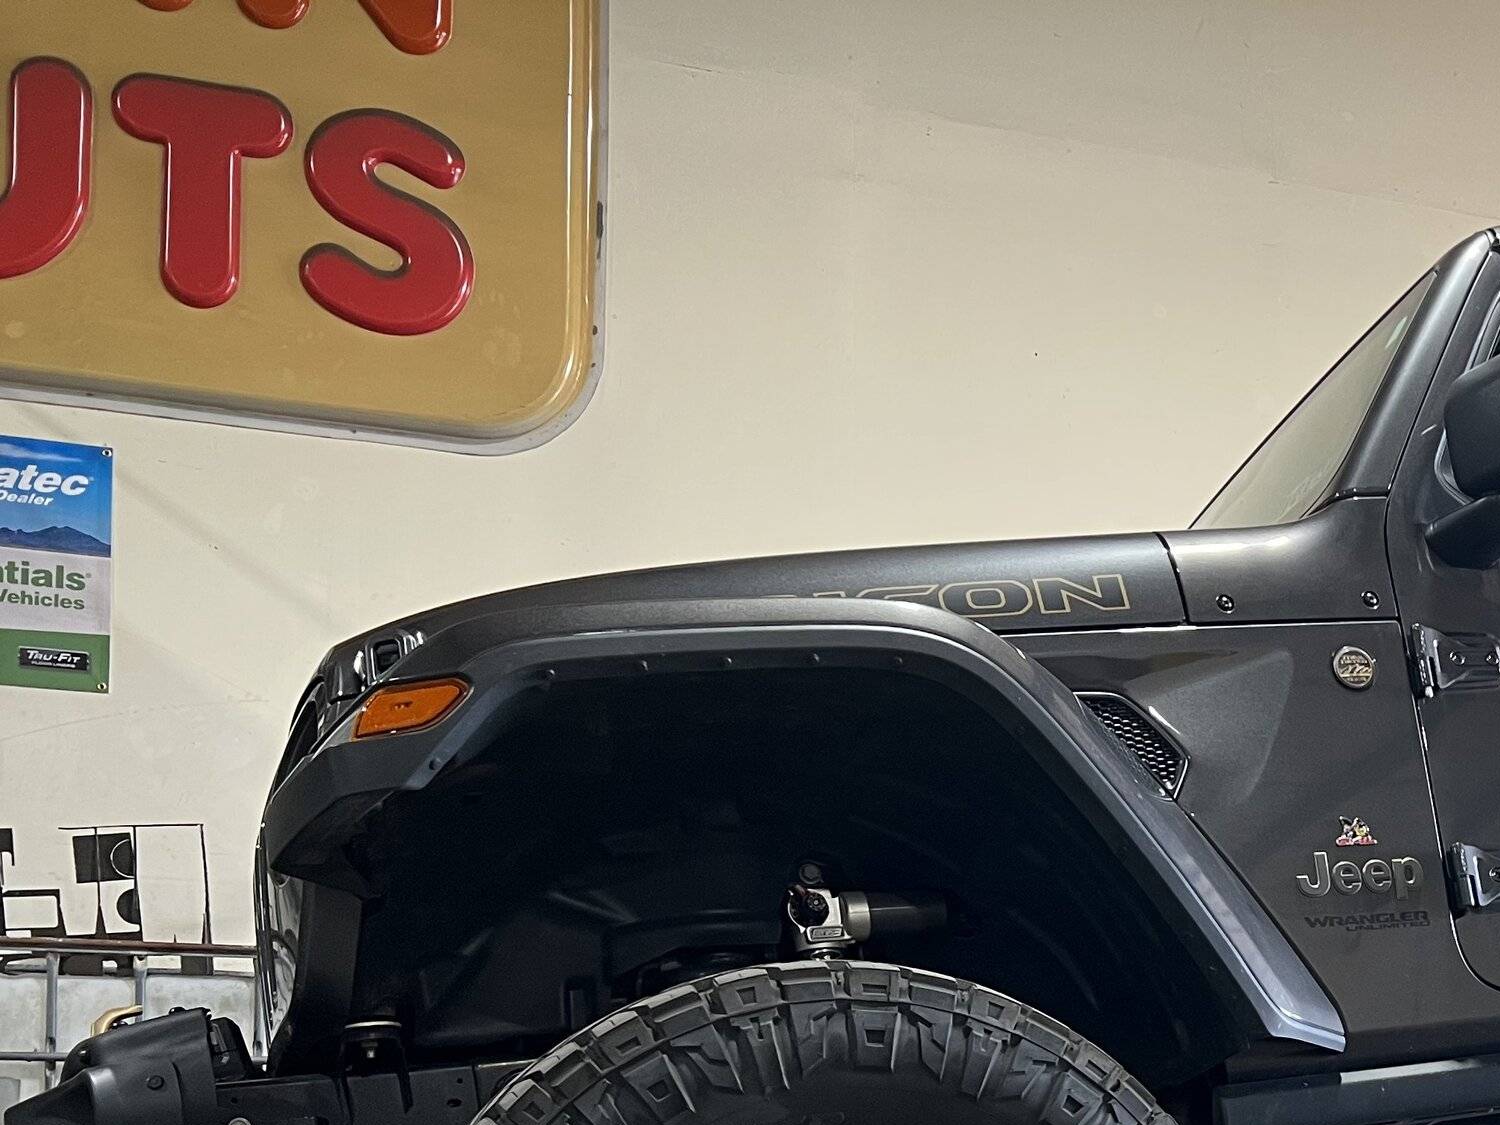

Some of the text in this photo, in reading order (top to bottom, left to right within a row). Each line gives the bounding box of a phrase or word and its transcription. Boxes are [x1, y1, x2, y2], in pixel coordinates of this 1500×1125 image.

[0, 560, 86, 591] tials
[1296, 851, 1425, 900] Jeep
[1303, 910, 1428, 928] WRANGLER
[1345, 920, 1431, 932] UNLIMITED
